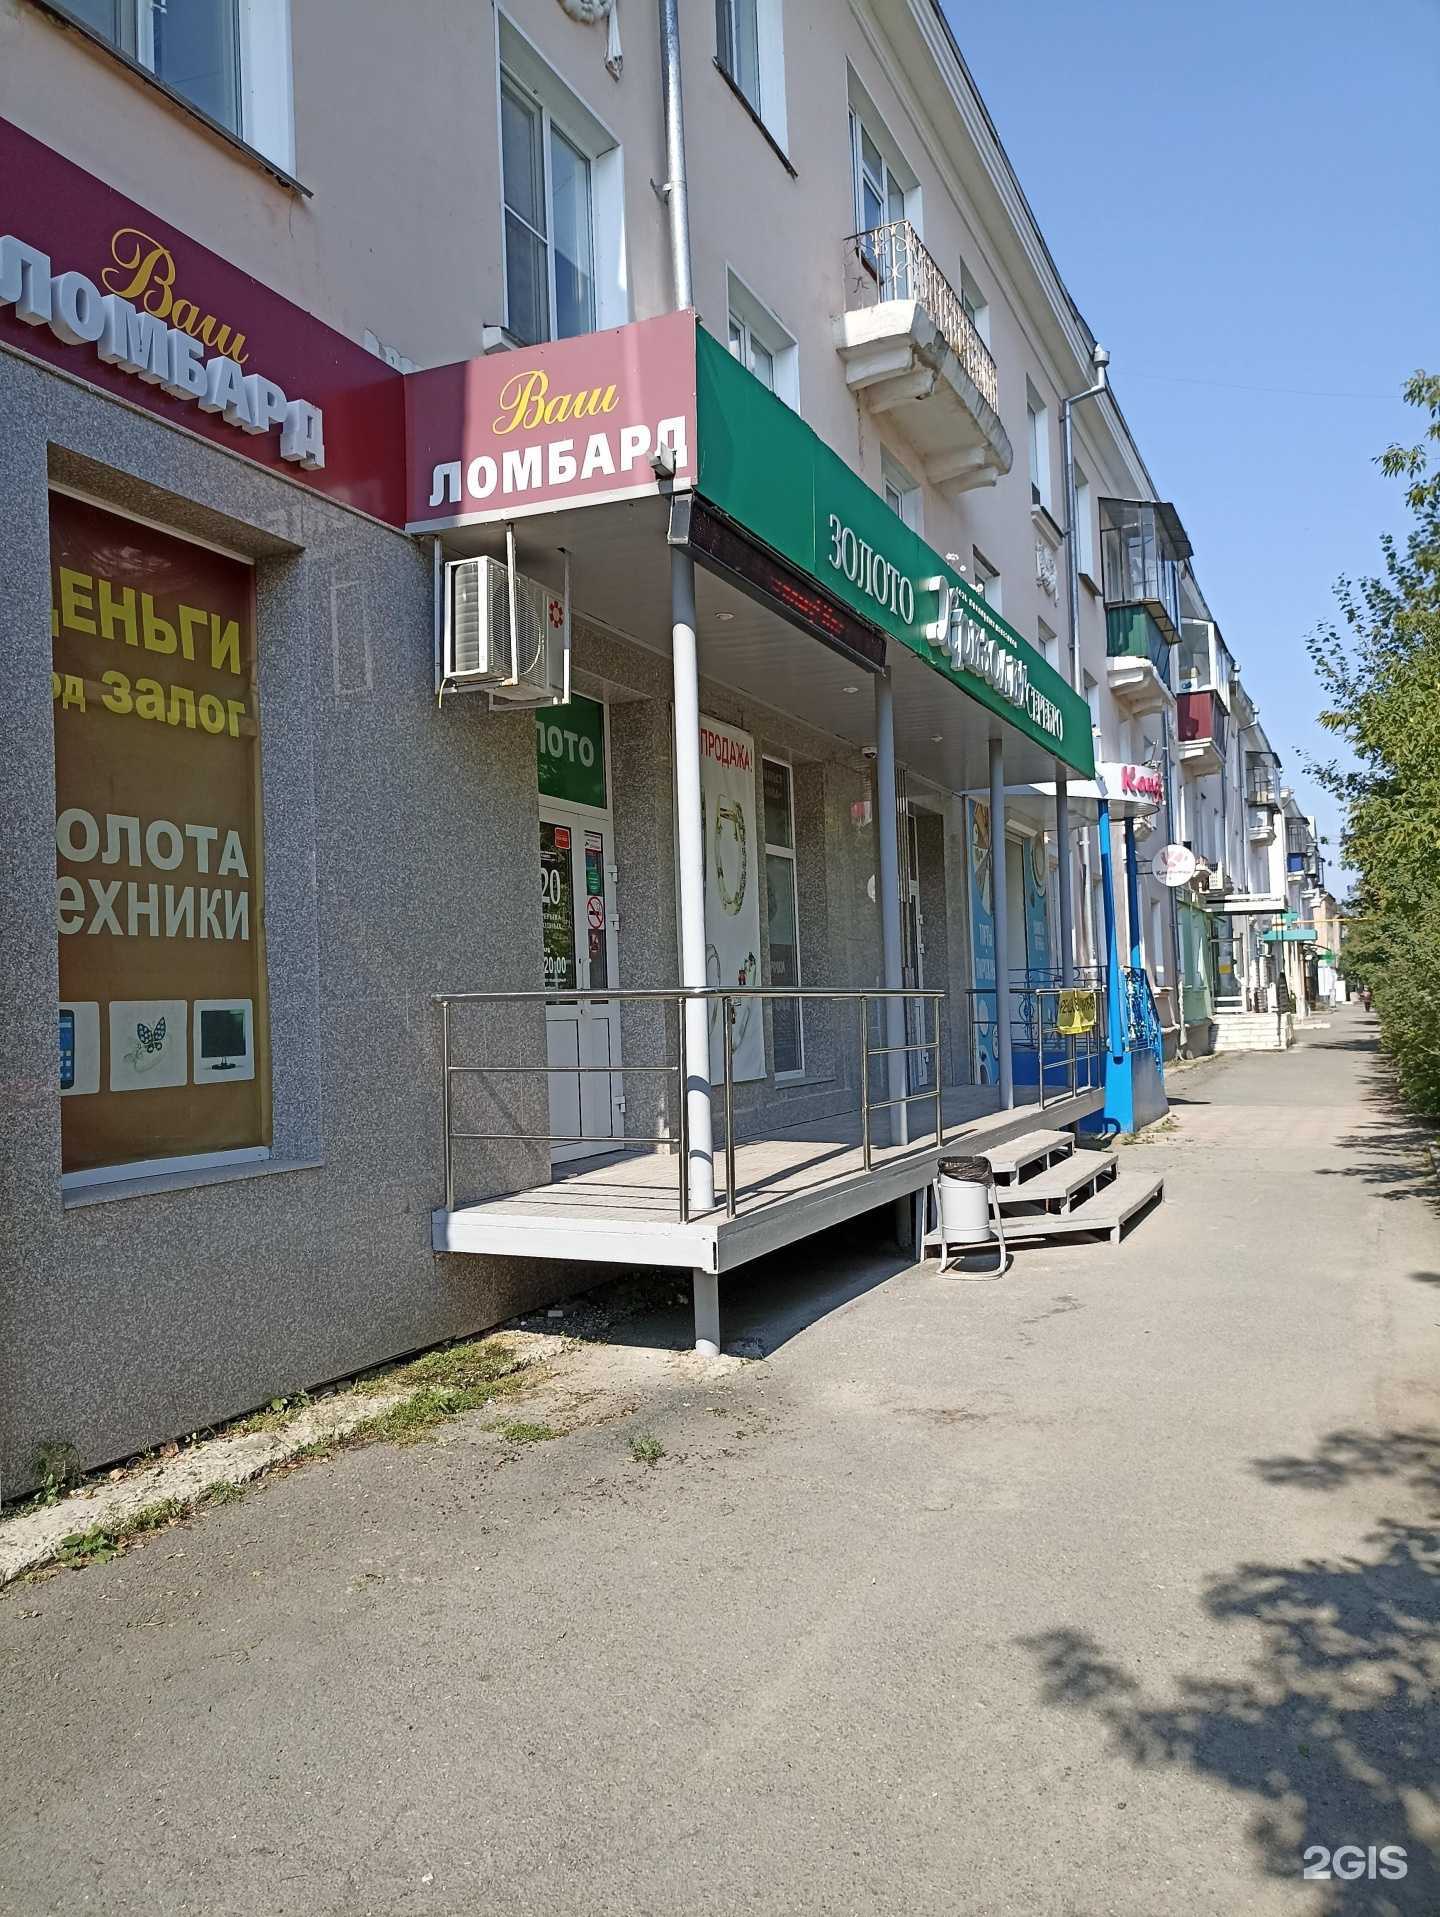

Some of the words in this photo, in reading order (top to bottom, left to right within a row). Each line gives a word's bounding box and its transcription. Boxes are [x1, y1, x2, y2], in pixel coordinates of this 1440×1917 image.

[102, 228, 249, 364] Ваш
[0, 234, 325, 471] ЛОМБАРД
[492, 369, 620, 436] Ваш
[429, 415, 689, 507] ЛОМБАРД
[828, 513, 915, 625] ЗОЛОТО
[51, 566, 241, 675] ЕНЬГИ
[536, 721, 594, 767] ЛОТО
[56, 808, 249, 878] ОЛОТА
[56, 876, 249, 940] ехники
